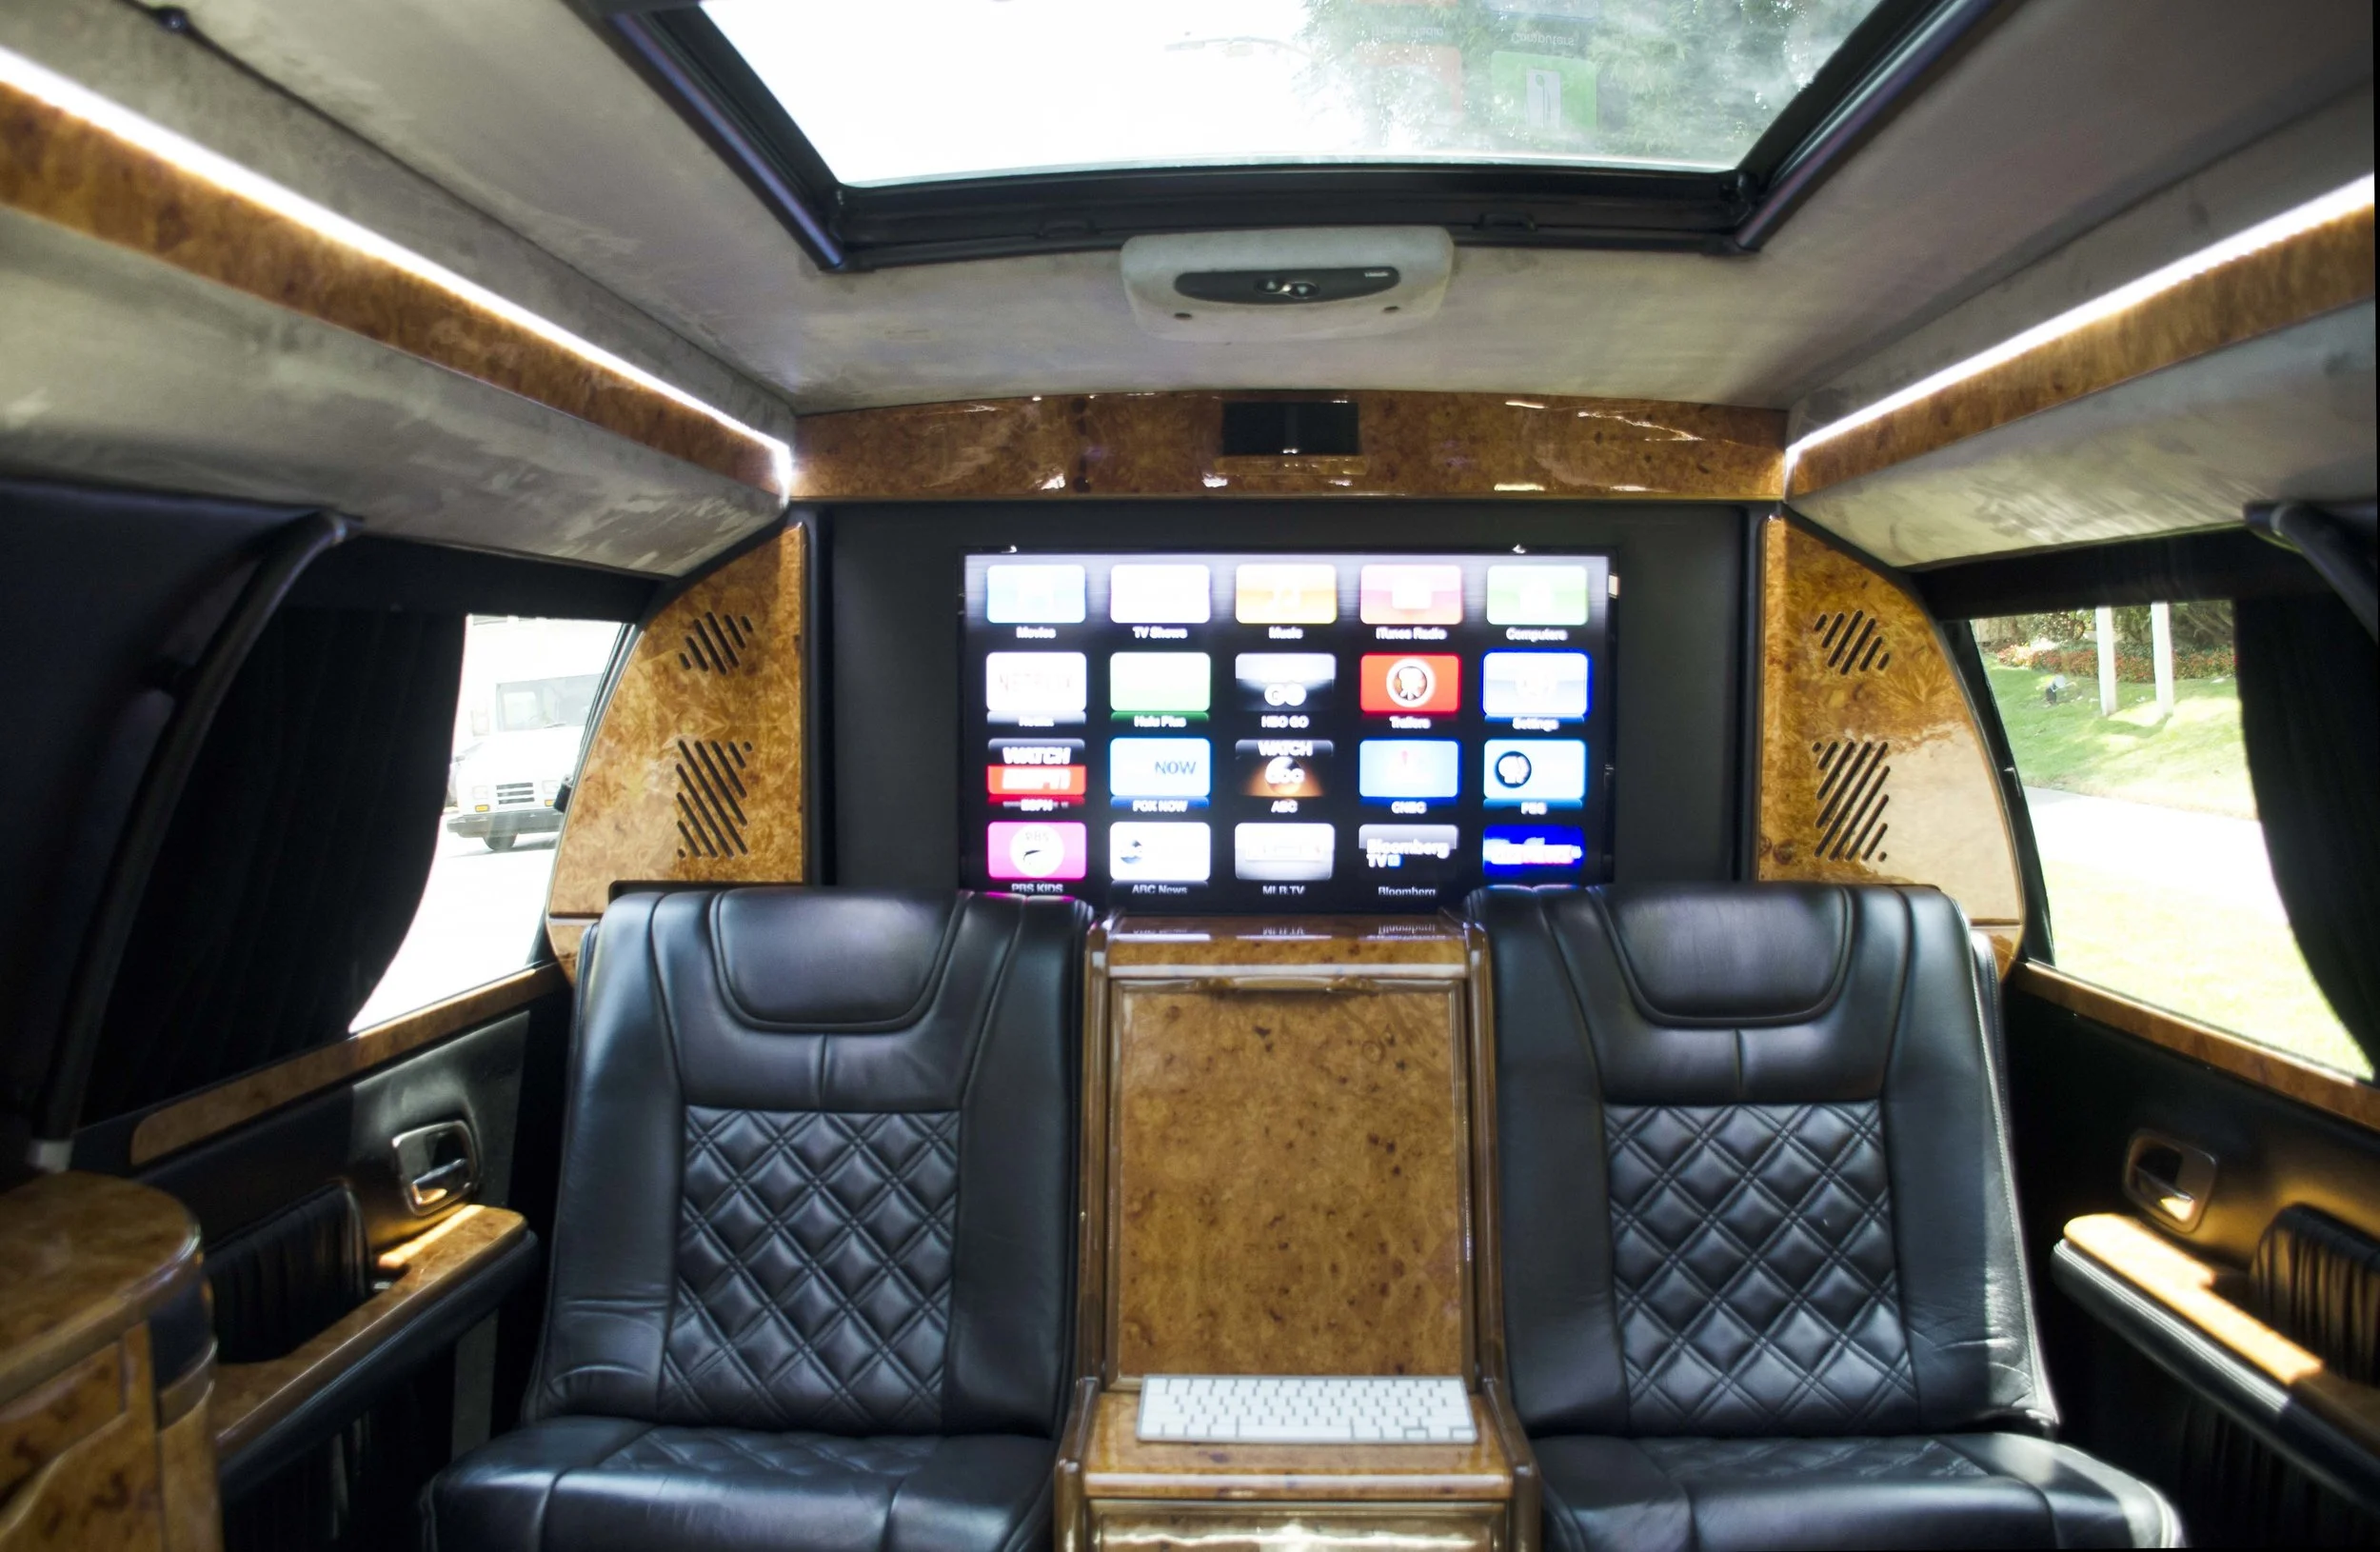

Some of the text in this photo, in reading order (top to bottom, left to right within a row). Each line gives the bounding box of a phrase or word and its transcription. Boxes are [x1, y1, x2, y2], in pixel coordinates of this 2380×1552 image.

[1016, 626, 1057, 639] Movies
[1132, 626, 1188, 639] TV Shows
[1268, 627, 1303, 639] Music
[1413, 627, 1448, 640] Radio
[1505, 627, 1569, 643] Computers
[1261, 715, 1288, 727] HBO
[1512, 716, 1559, 732] Settings
[1257, 740, 1313, 757] WATCH
[1002, 746, 1072, 765] WATCH
[1155, 760, 1198, 775] NOW
[1133, 800, 1188, 812] FOX NOW
[1271, 800, 1299, 813] ABC
[1366, 839, 1451, 860] Bloomberg
[1366, 853, 1388, 868] TV
[1011, 883, 1063, 893] PBS KIDS
[1132, 884, 1187, 895] ABC News
[1378, 885, 1437, 897] Bloomberg
